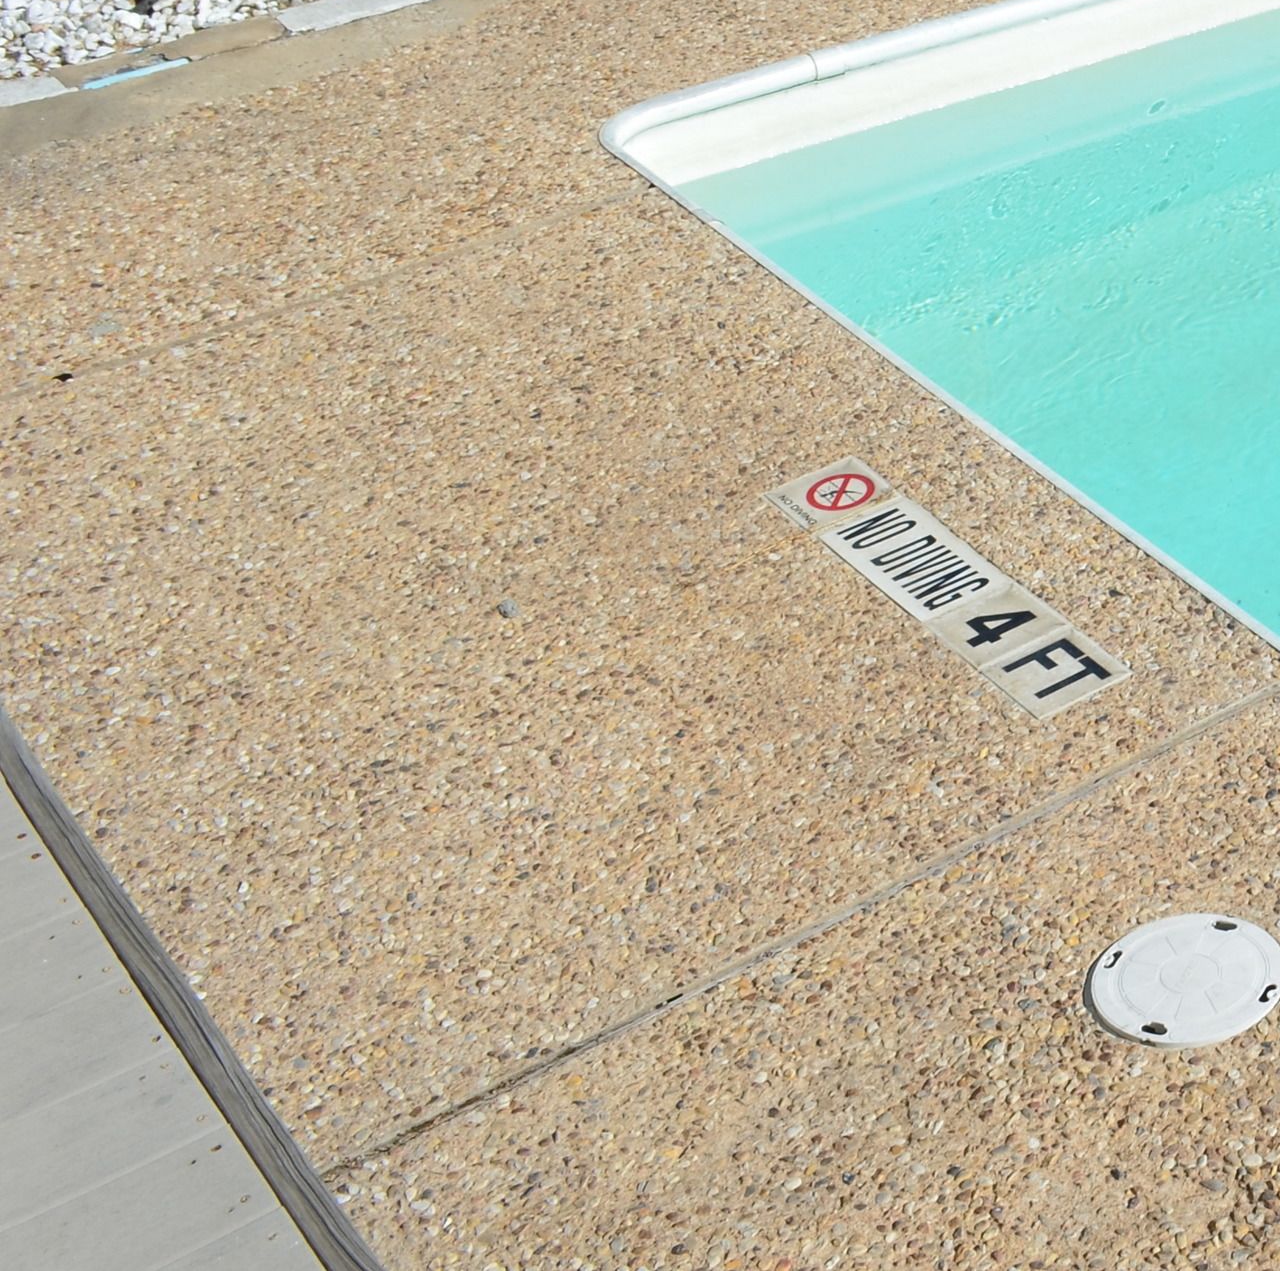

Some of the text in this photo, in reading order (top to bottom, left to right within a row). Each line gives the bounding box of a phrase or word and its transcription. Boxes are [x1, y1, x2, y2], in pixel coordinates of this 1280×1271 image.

[777, 494, 818, 526] NO DIVING
[836, 508, 1113, 700] NO DIVING 4 FT
